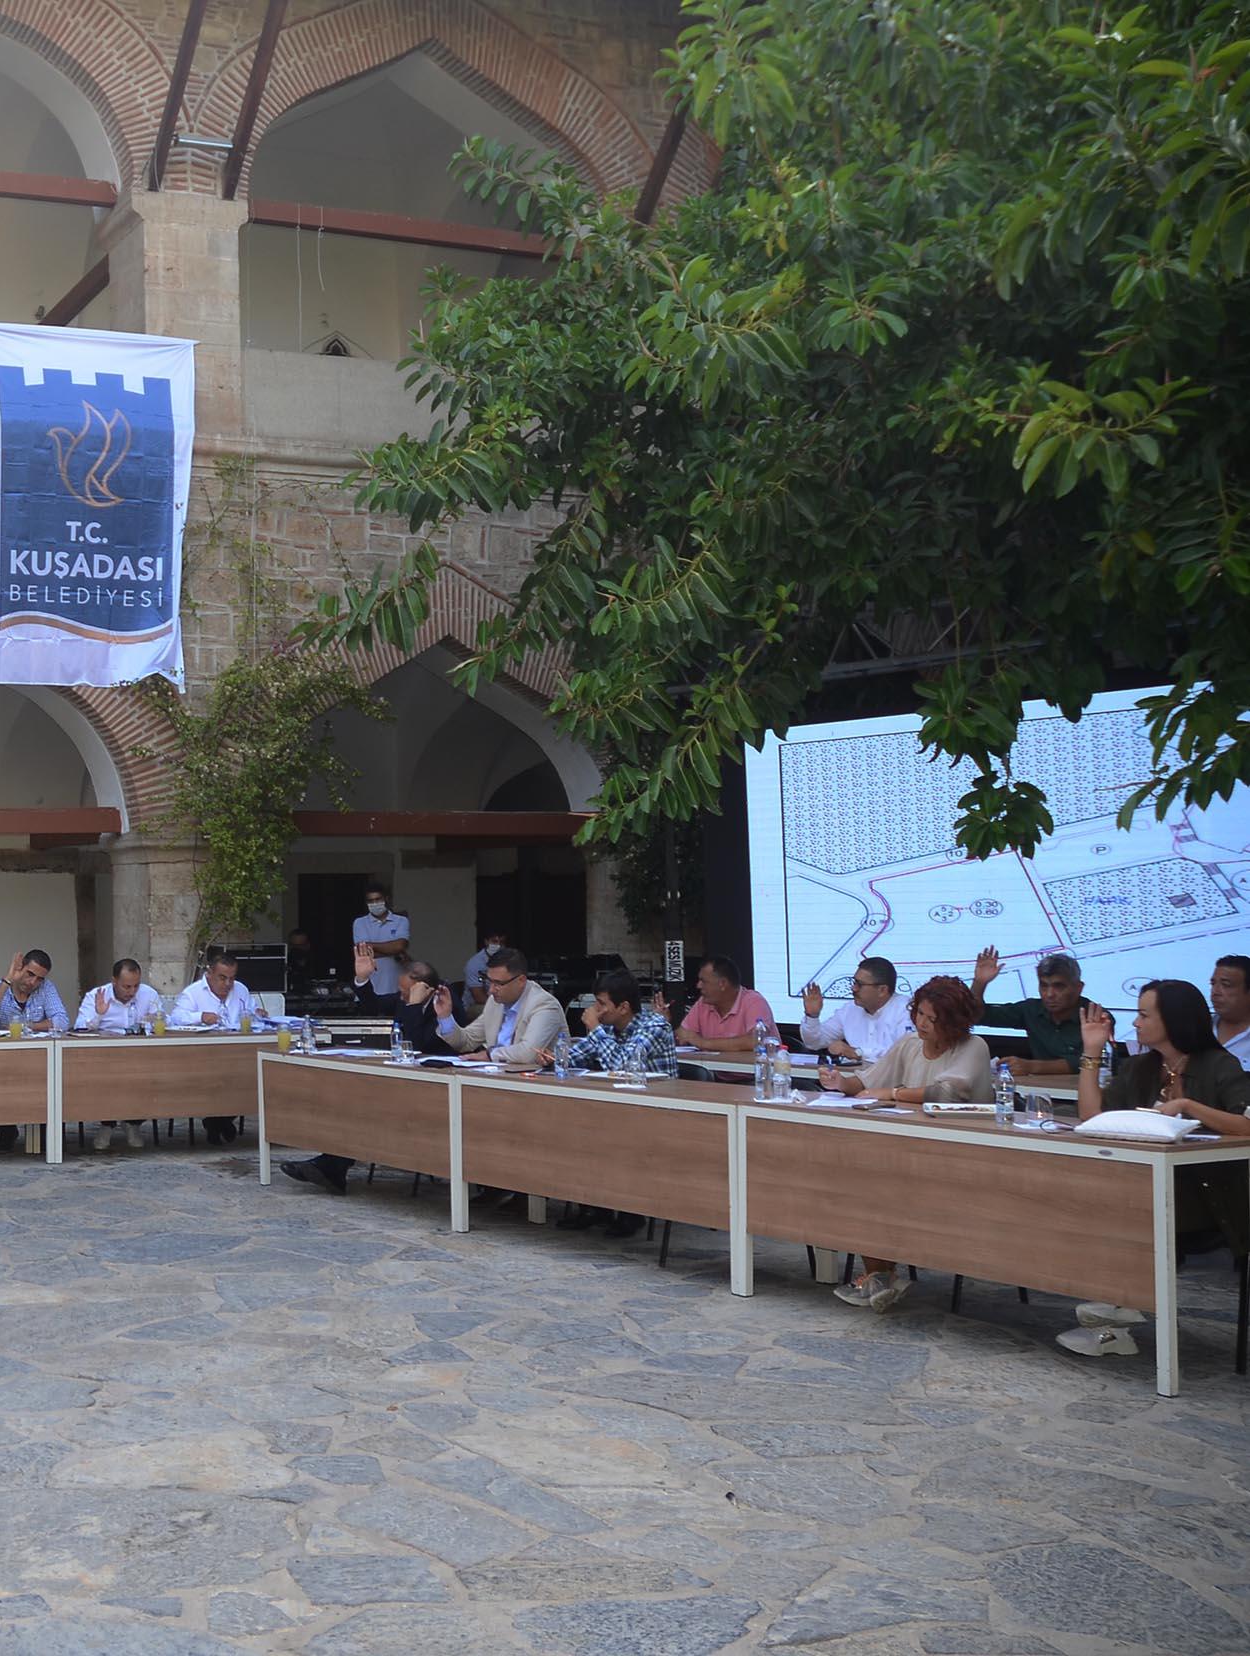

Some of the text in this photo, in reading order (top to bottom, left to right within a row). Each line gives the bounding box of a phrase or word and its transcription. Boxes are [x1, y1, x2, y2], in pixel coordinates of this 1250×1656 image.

[66, 520, 108, 543] T.C.
[10, 549, 163, 581] KUŞADASI
[10, 584, 162, 607] BELEDİYESİ
[1096, 846, 1106, 854] P
